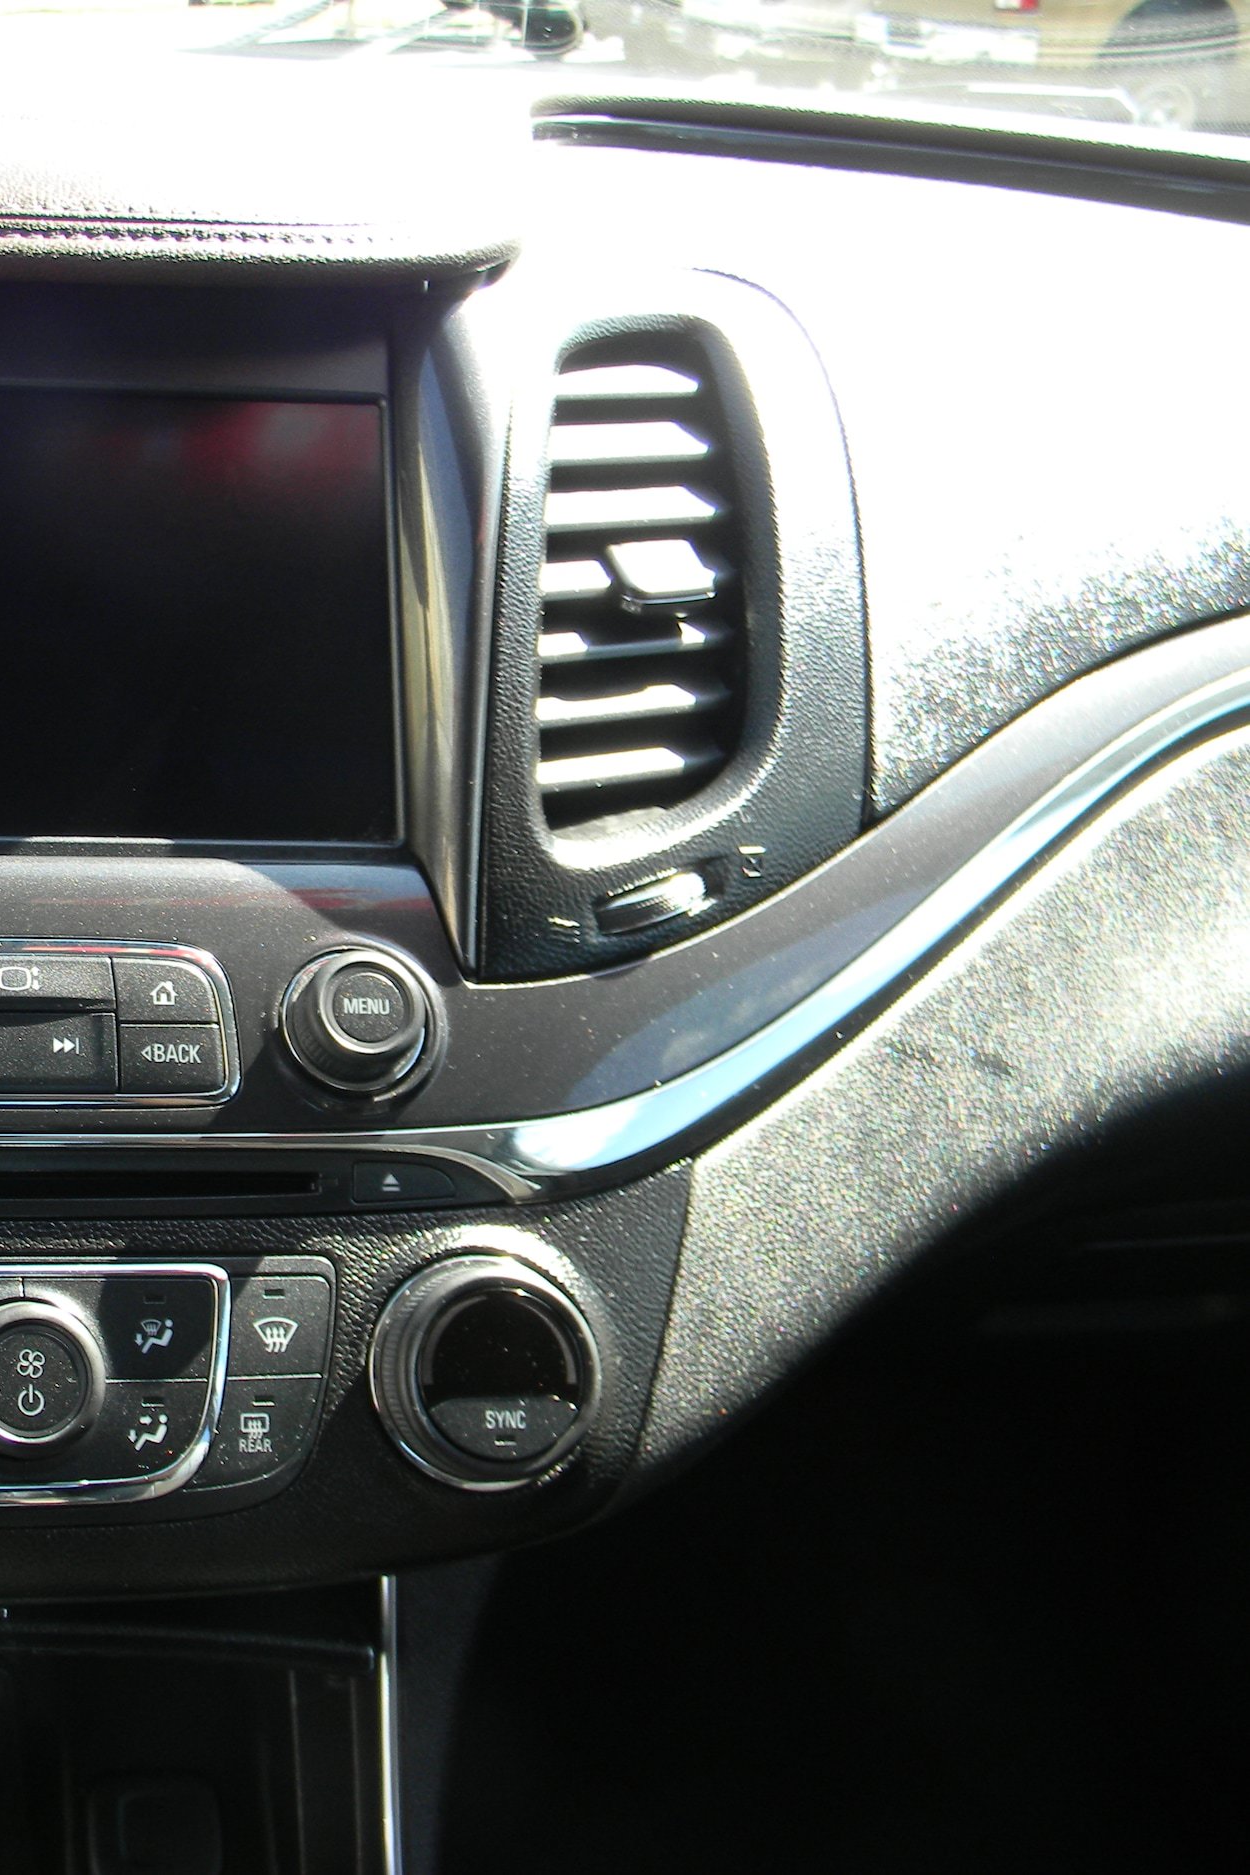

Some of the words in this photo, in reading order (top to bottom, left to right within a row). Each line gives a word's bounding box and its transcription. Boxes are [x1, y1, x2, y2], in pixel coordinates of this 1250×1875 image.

[343, 997, 391, 1015] MENU
[153, 1044, 202, 1064] BACK
[485, 1409, 527, 1430] SYNC
[238, 1436, 273, 1454] REAR
